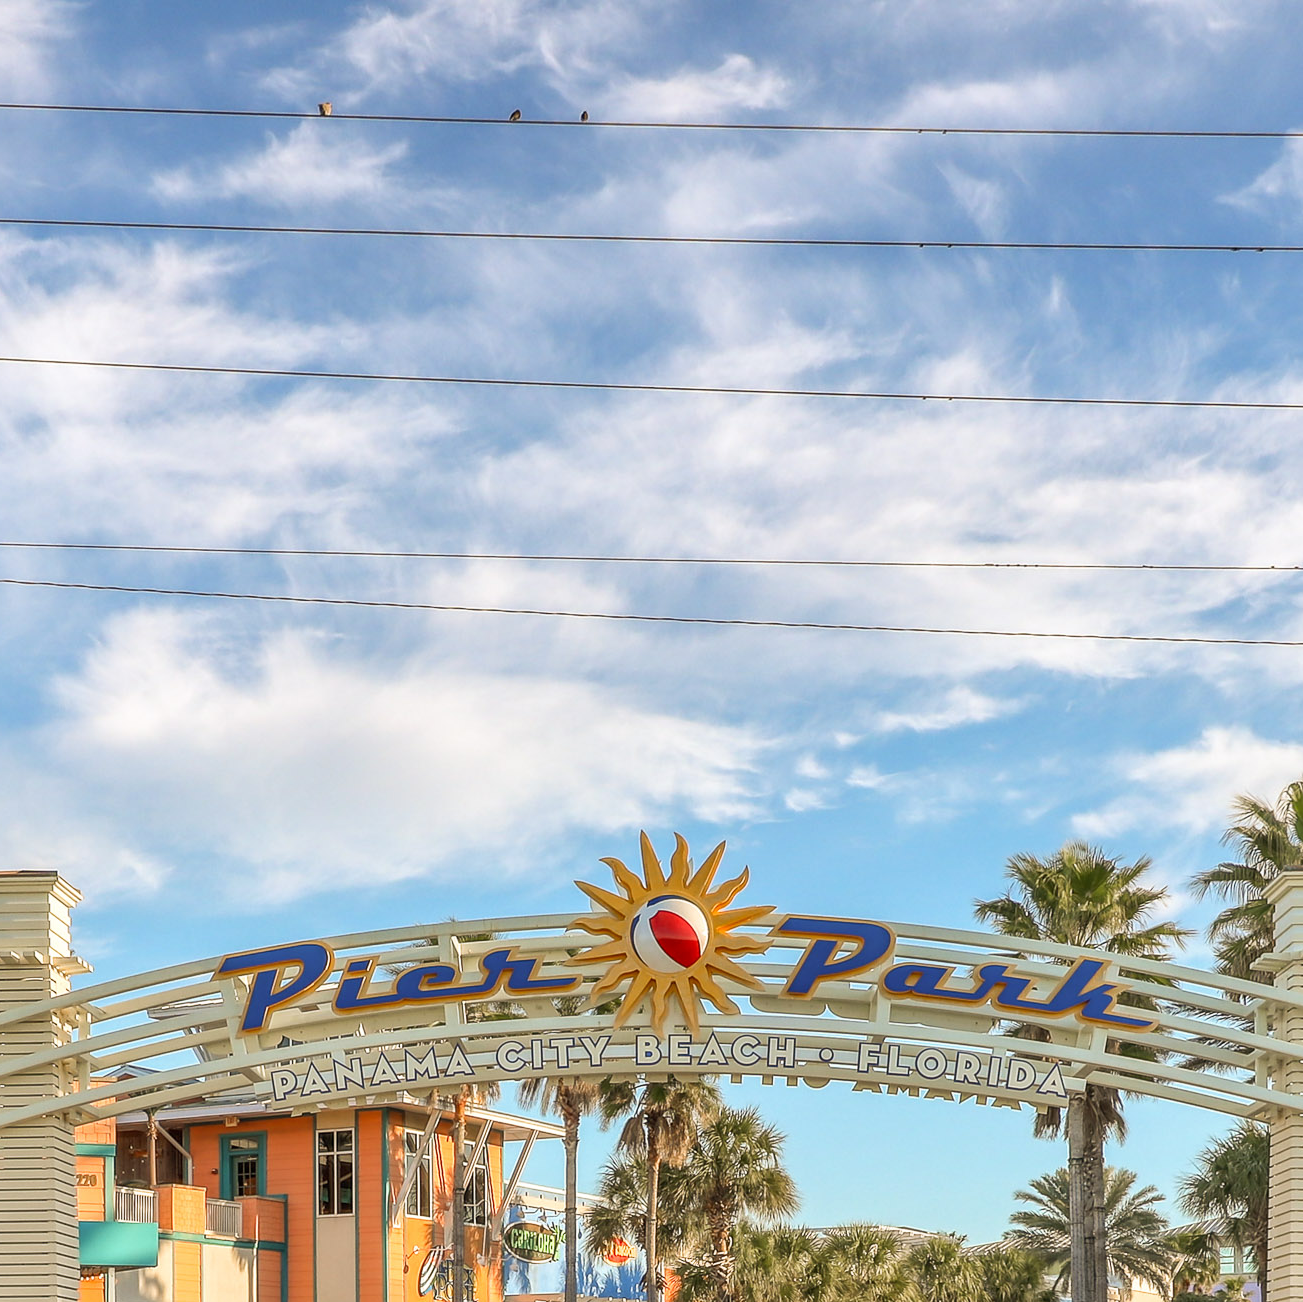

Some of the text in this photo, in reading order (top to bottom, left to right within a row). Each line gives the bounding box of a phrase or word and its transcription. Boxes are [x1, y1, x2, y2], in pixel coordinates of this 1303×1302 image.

[211, 913, 1160, 1038] Pier Park
[271, 1043, 475, 1101] PANAMA
[496, 1035, 611, 1072] CITY
[635, 1031, 796, 1068] BEACH
[857, 1043, 1068, 1098] FLORIDA
[76, 1173, 97, 1187] 220
